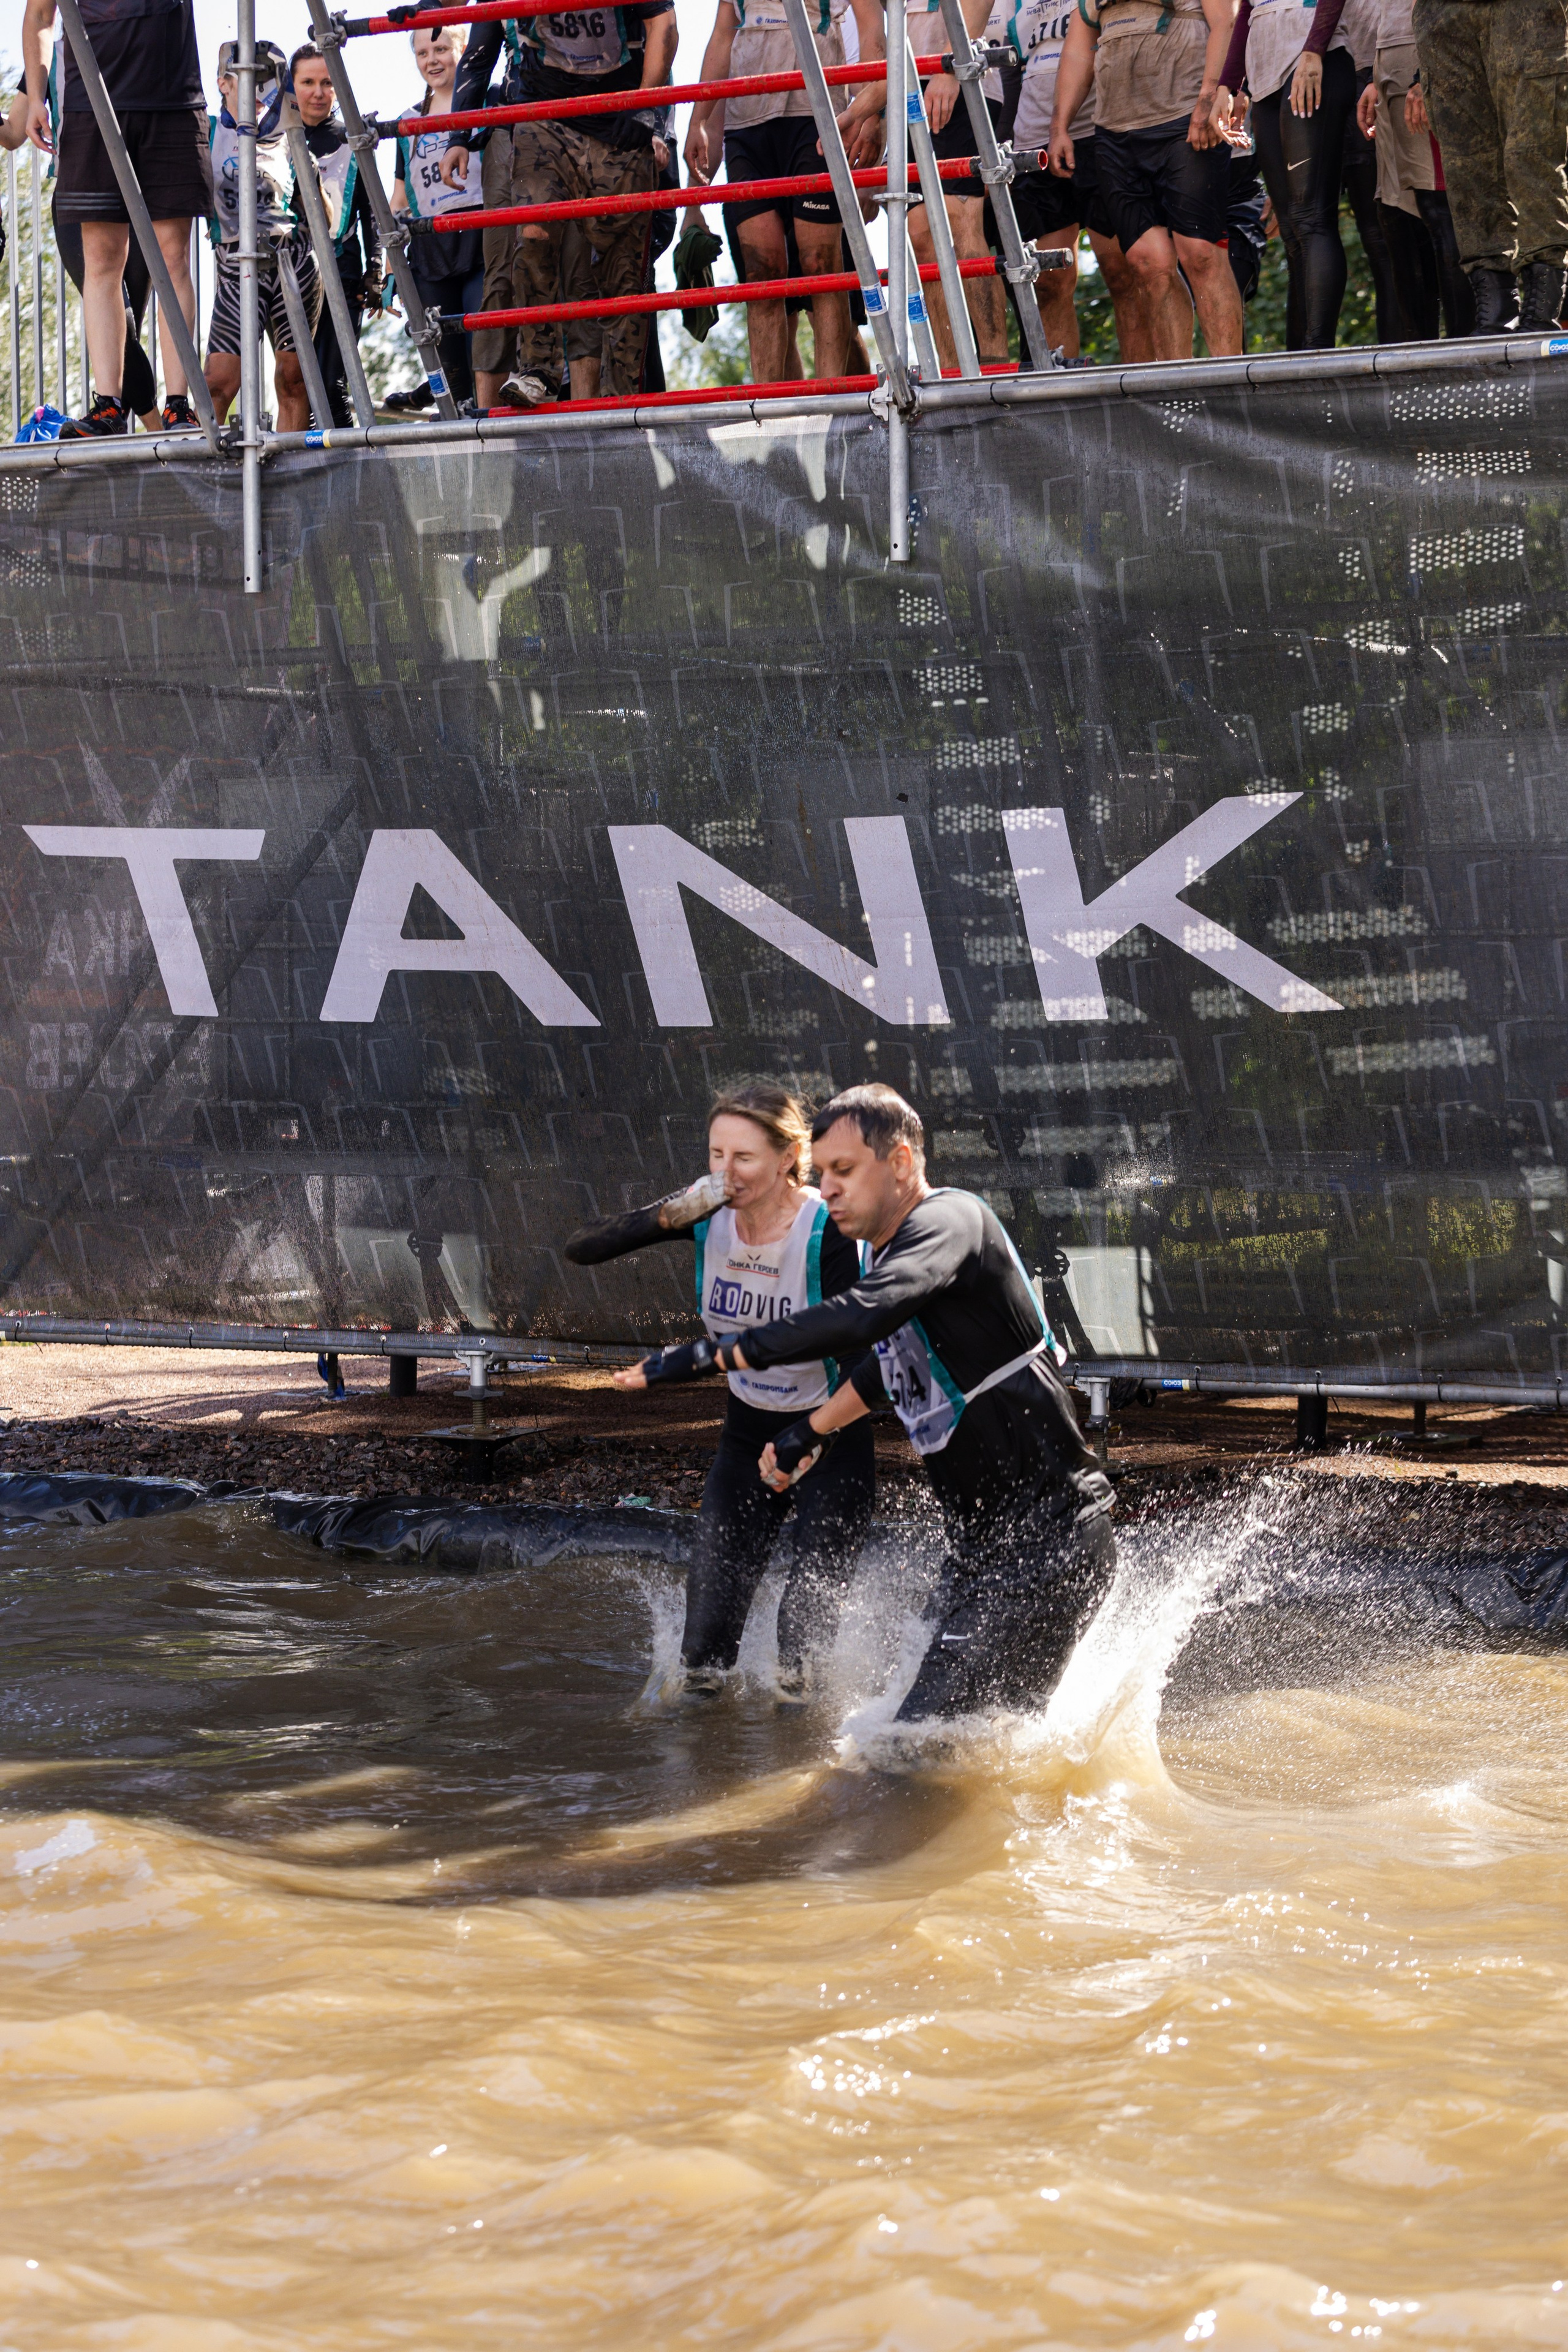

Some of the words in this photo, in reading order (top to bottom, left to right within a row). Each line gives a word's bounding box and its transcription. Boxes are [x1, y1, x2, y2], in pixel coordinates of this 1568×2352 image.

[548, 12, 606, 38] 5816
[22, 792, 1344, 1027] TANK
[753, 1263, 778, 1275] ГЕРОЕВ
[710, 1283, 791, 1322] RODVIG
[752, 1382, 798, 1393] ГАЗПРОМБАНК
